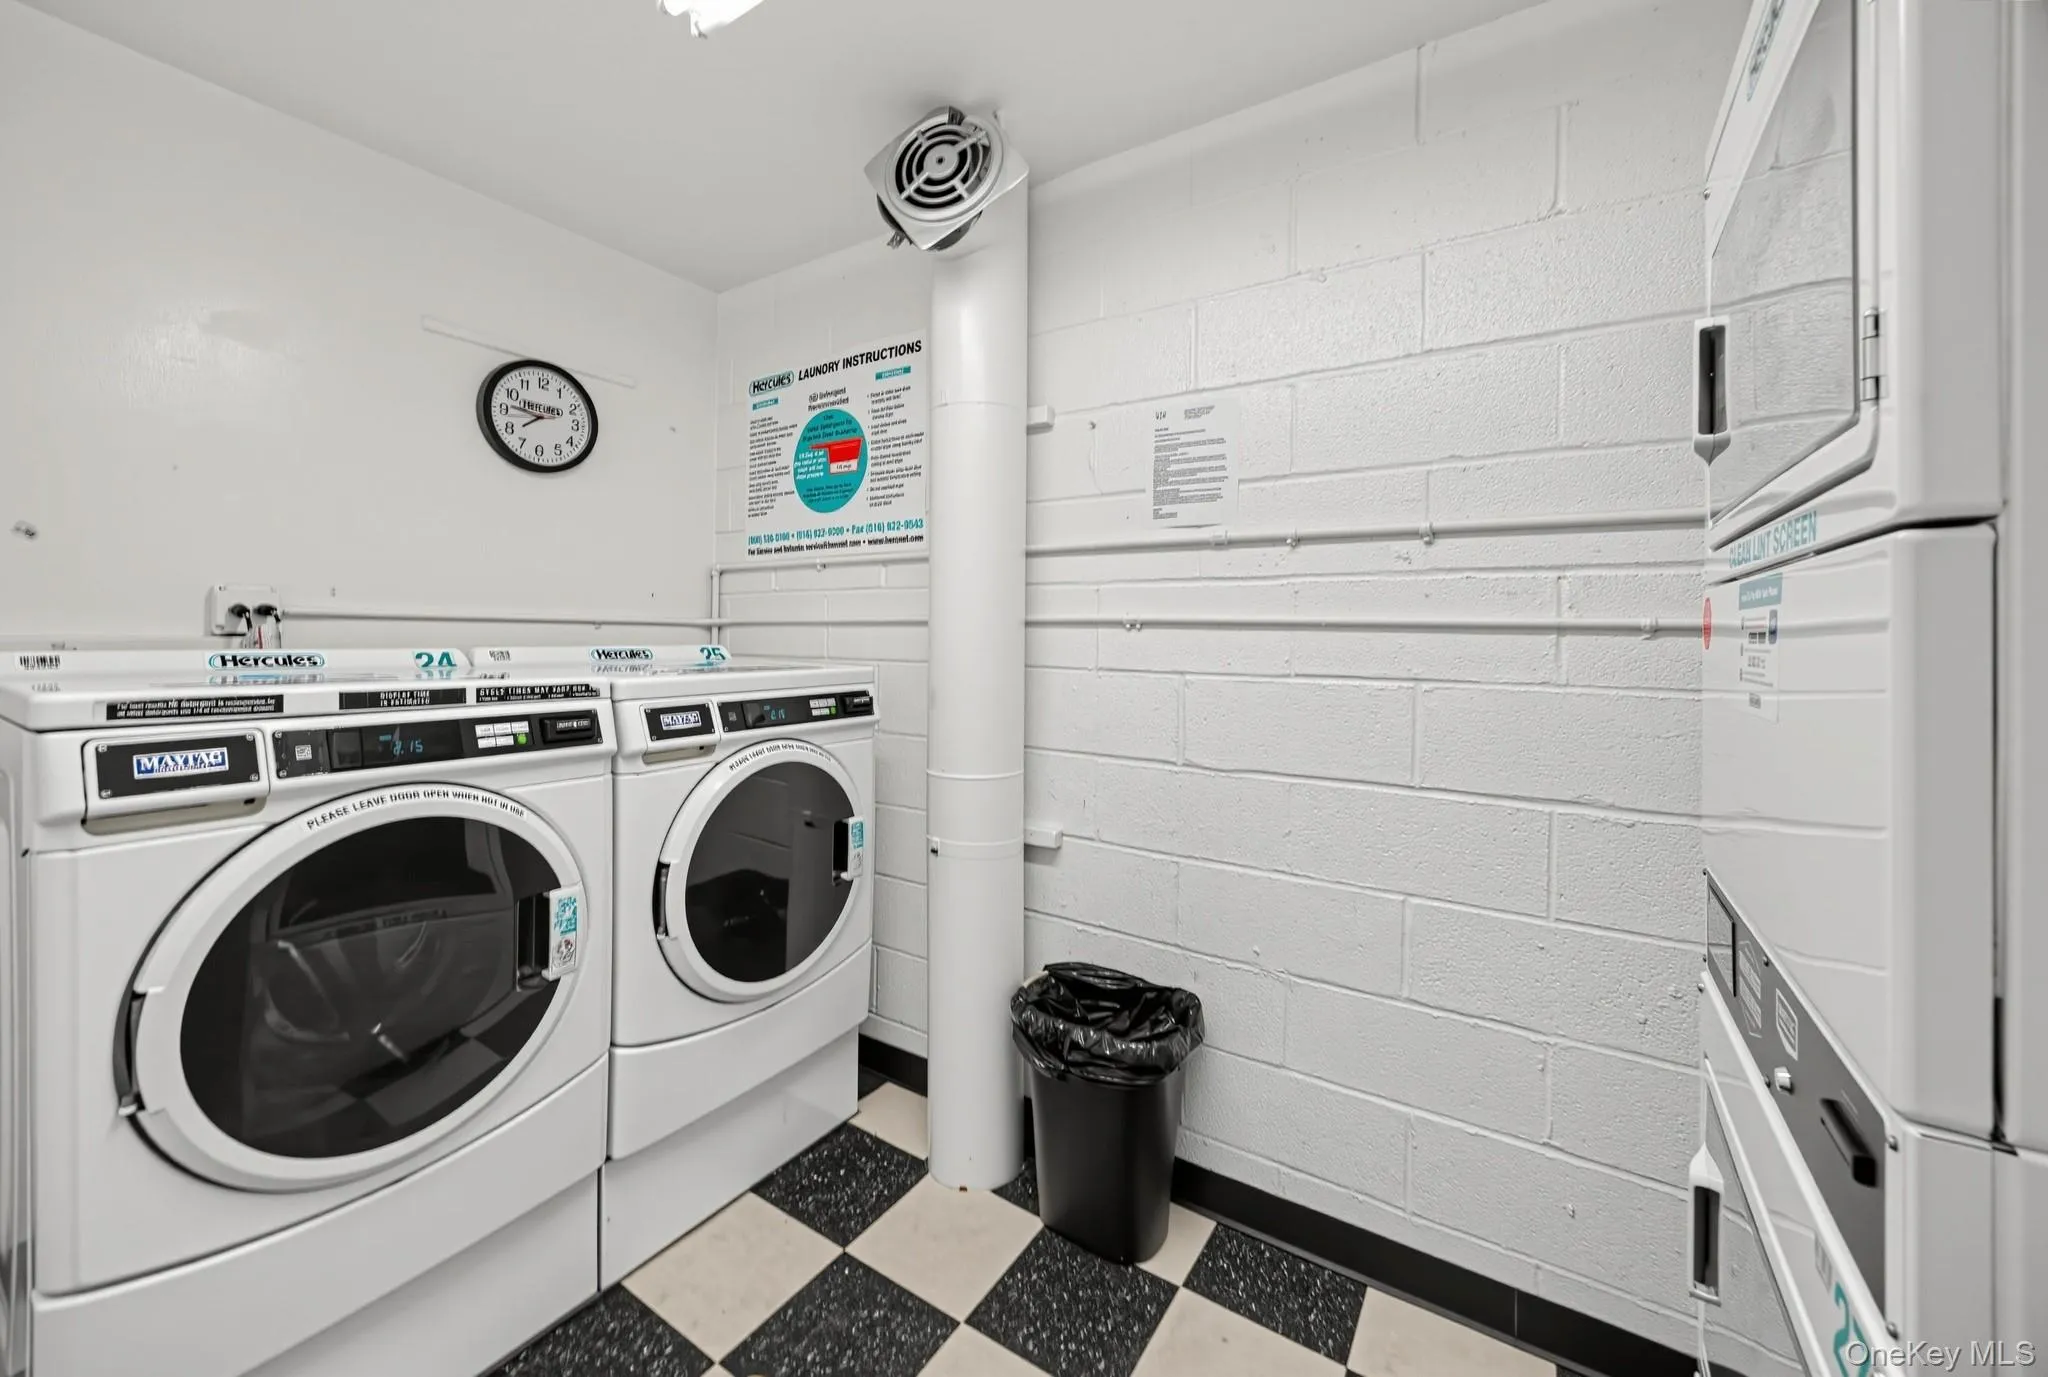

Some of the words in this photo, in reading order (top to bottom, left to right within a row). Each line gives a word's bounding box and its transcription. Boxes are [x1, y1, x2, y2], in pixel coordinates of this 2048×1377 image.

[752, 373, 791, 394] Hercules
[842, 340, 922, 370] INSTRUCTIONS
[521, 378, 529, 391] 11
[538, 377, 549, 391] 12
[505, 388, 519, 401] 10
[557, 387, 562, 399] 1
[500, 403, 509, 415] 9
[569, 403, 577, 416] 2
[505, 422, 514, 435] 8
[571, 419, 579, 432] 3
[518, 437, 526, 449] 7
[566, 436, 574, 447] 4
[535, 445, 544, 457] 6
[554, 444, 562, 456] 5
[1729, 539, 1751, 569] CLEAN
[1753, 530, 1771, 561] LINT
[1773, 510, 1817, 554] SCREEN
[220, 654, 318, 667] Hercules
[596, 648, 651, 660] Hercules
[534, 686, 548, 694] MAY
[139, 751, 223, 771] MAYTAG
[307, 805, 349, 830] PLEASE
[352, 795, 386, 812] LEAVE
[389, 790, 420, 803] DOOR
[423, 789, 449, 799] OPEN
[451, 790, 479, 801] WHEN
[481, 795, 498, 807] NOT
